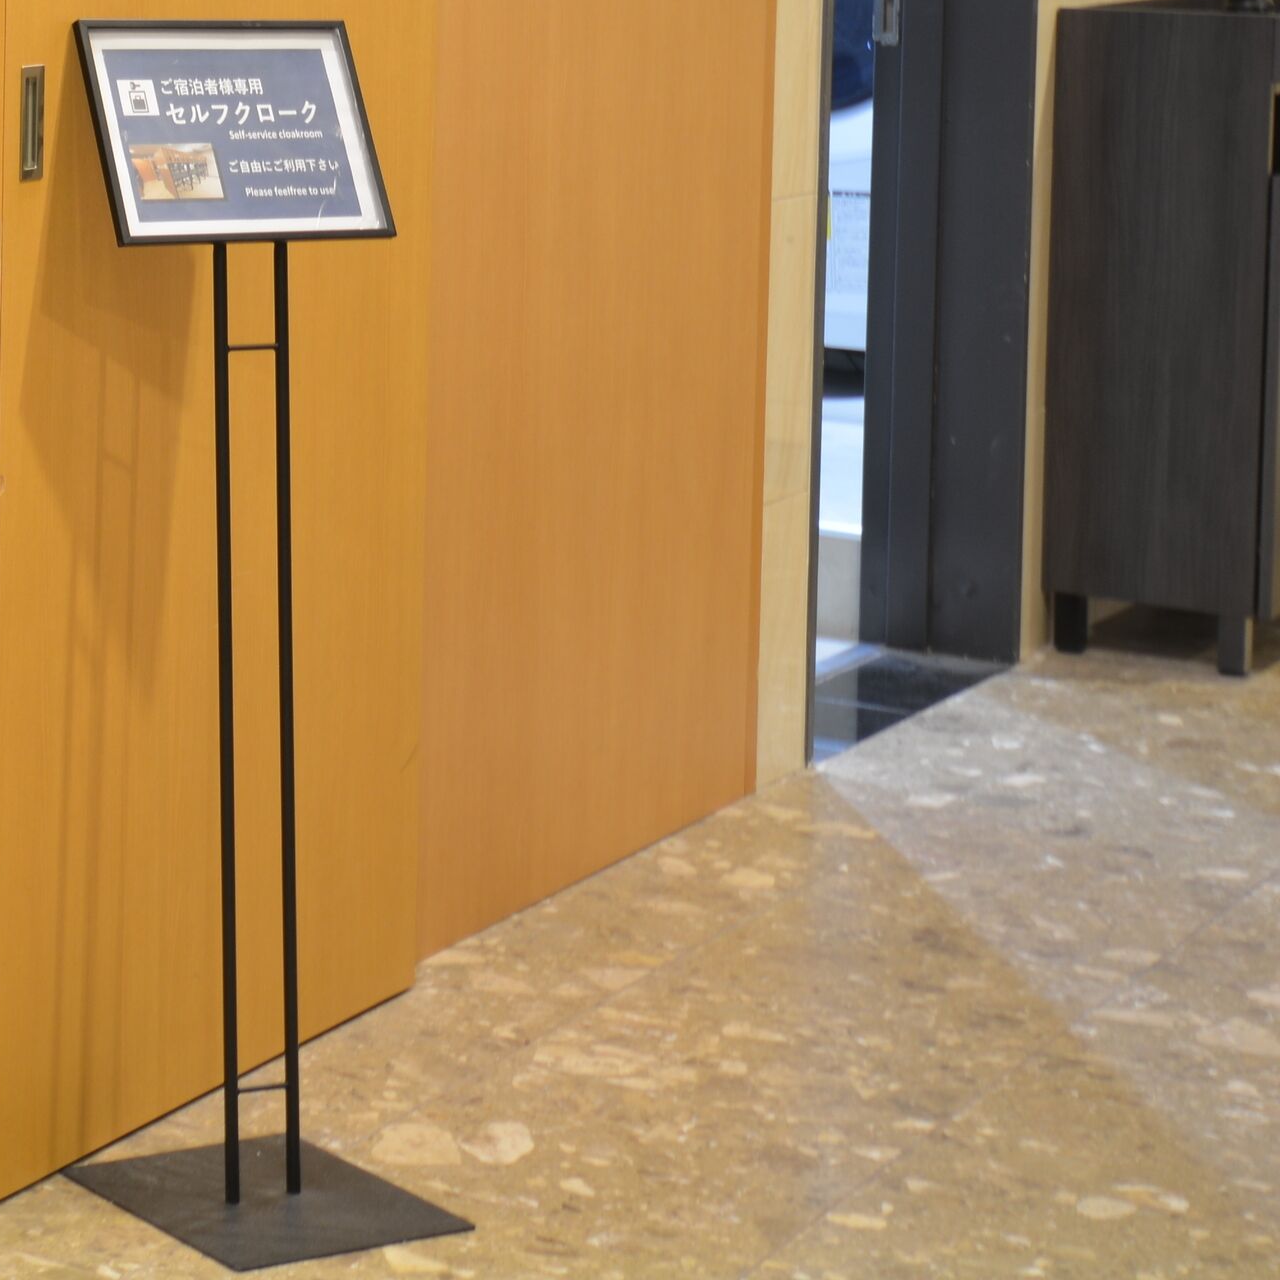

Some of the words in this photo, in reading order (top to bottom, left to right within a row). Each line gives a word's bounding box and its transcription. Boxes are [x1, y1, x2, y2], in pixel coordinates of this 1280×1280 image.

[160, 78, 264, 96] ご宿泊者様専用
[165, 100, 317, 125] セルフクローク
[229, 129, 277, 141] Self-service
[278, 128, 323, 140] cloakroom
[228, 158, 338, 174] ご自由にご利用下さい
[245, 186, 273, 197] Please
[308, 186, 319, 196] to
